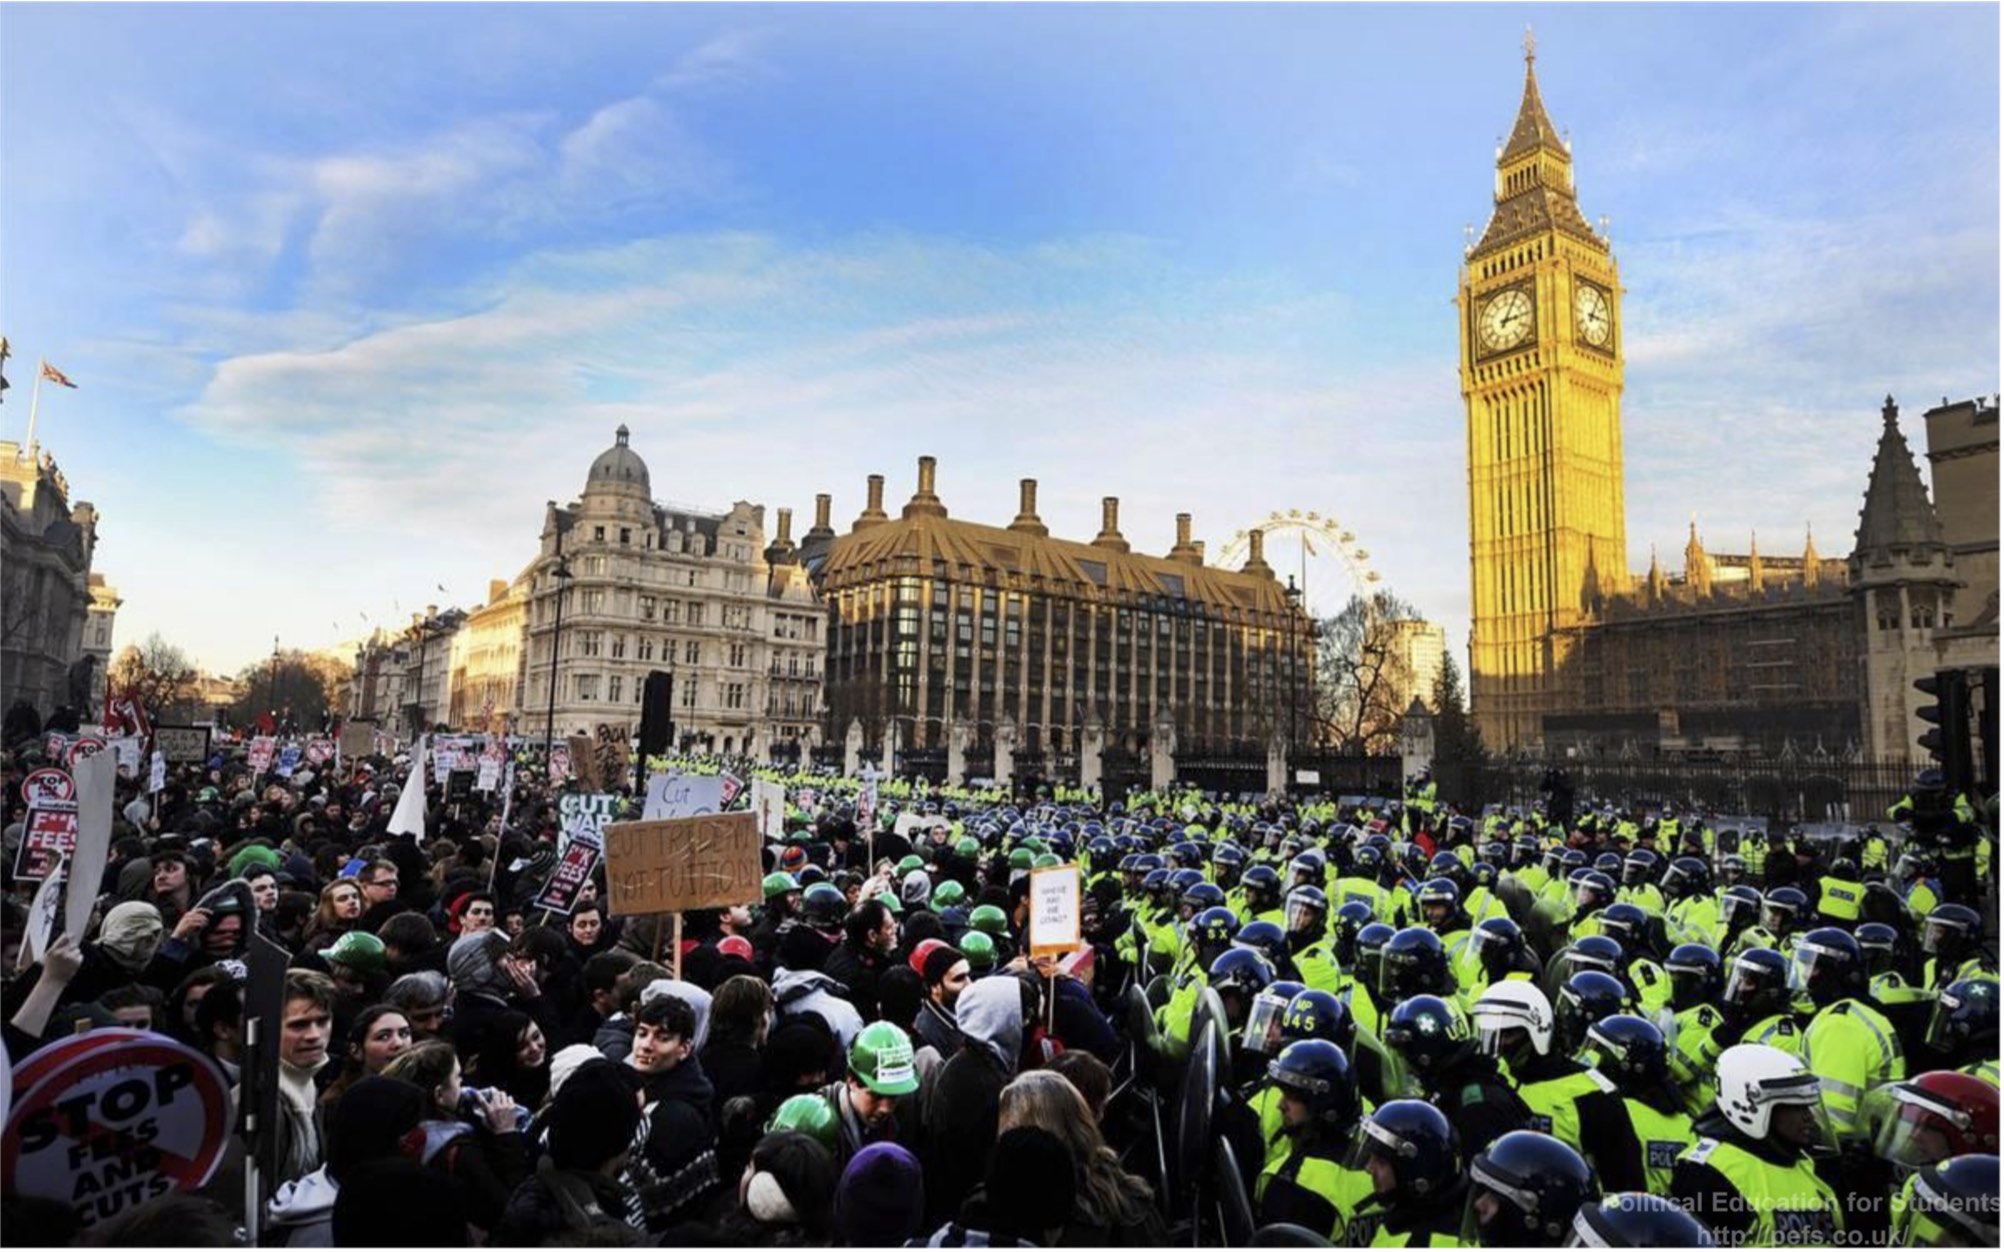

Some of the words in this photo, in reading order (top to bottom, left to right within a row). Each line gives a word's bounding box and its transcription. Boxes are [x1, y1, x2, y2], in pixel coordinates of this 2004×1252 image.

[560, 793, 615, 815] CUT
[18, 1061, 196, 1155] STOP
[67, 1117, 159, 1171] FEES
[72, 1148, 162, 1200] AND
[76, 1172, 170, 1229] CUTS
